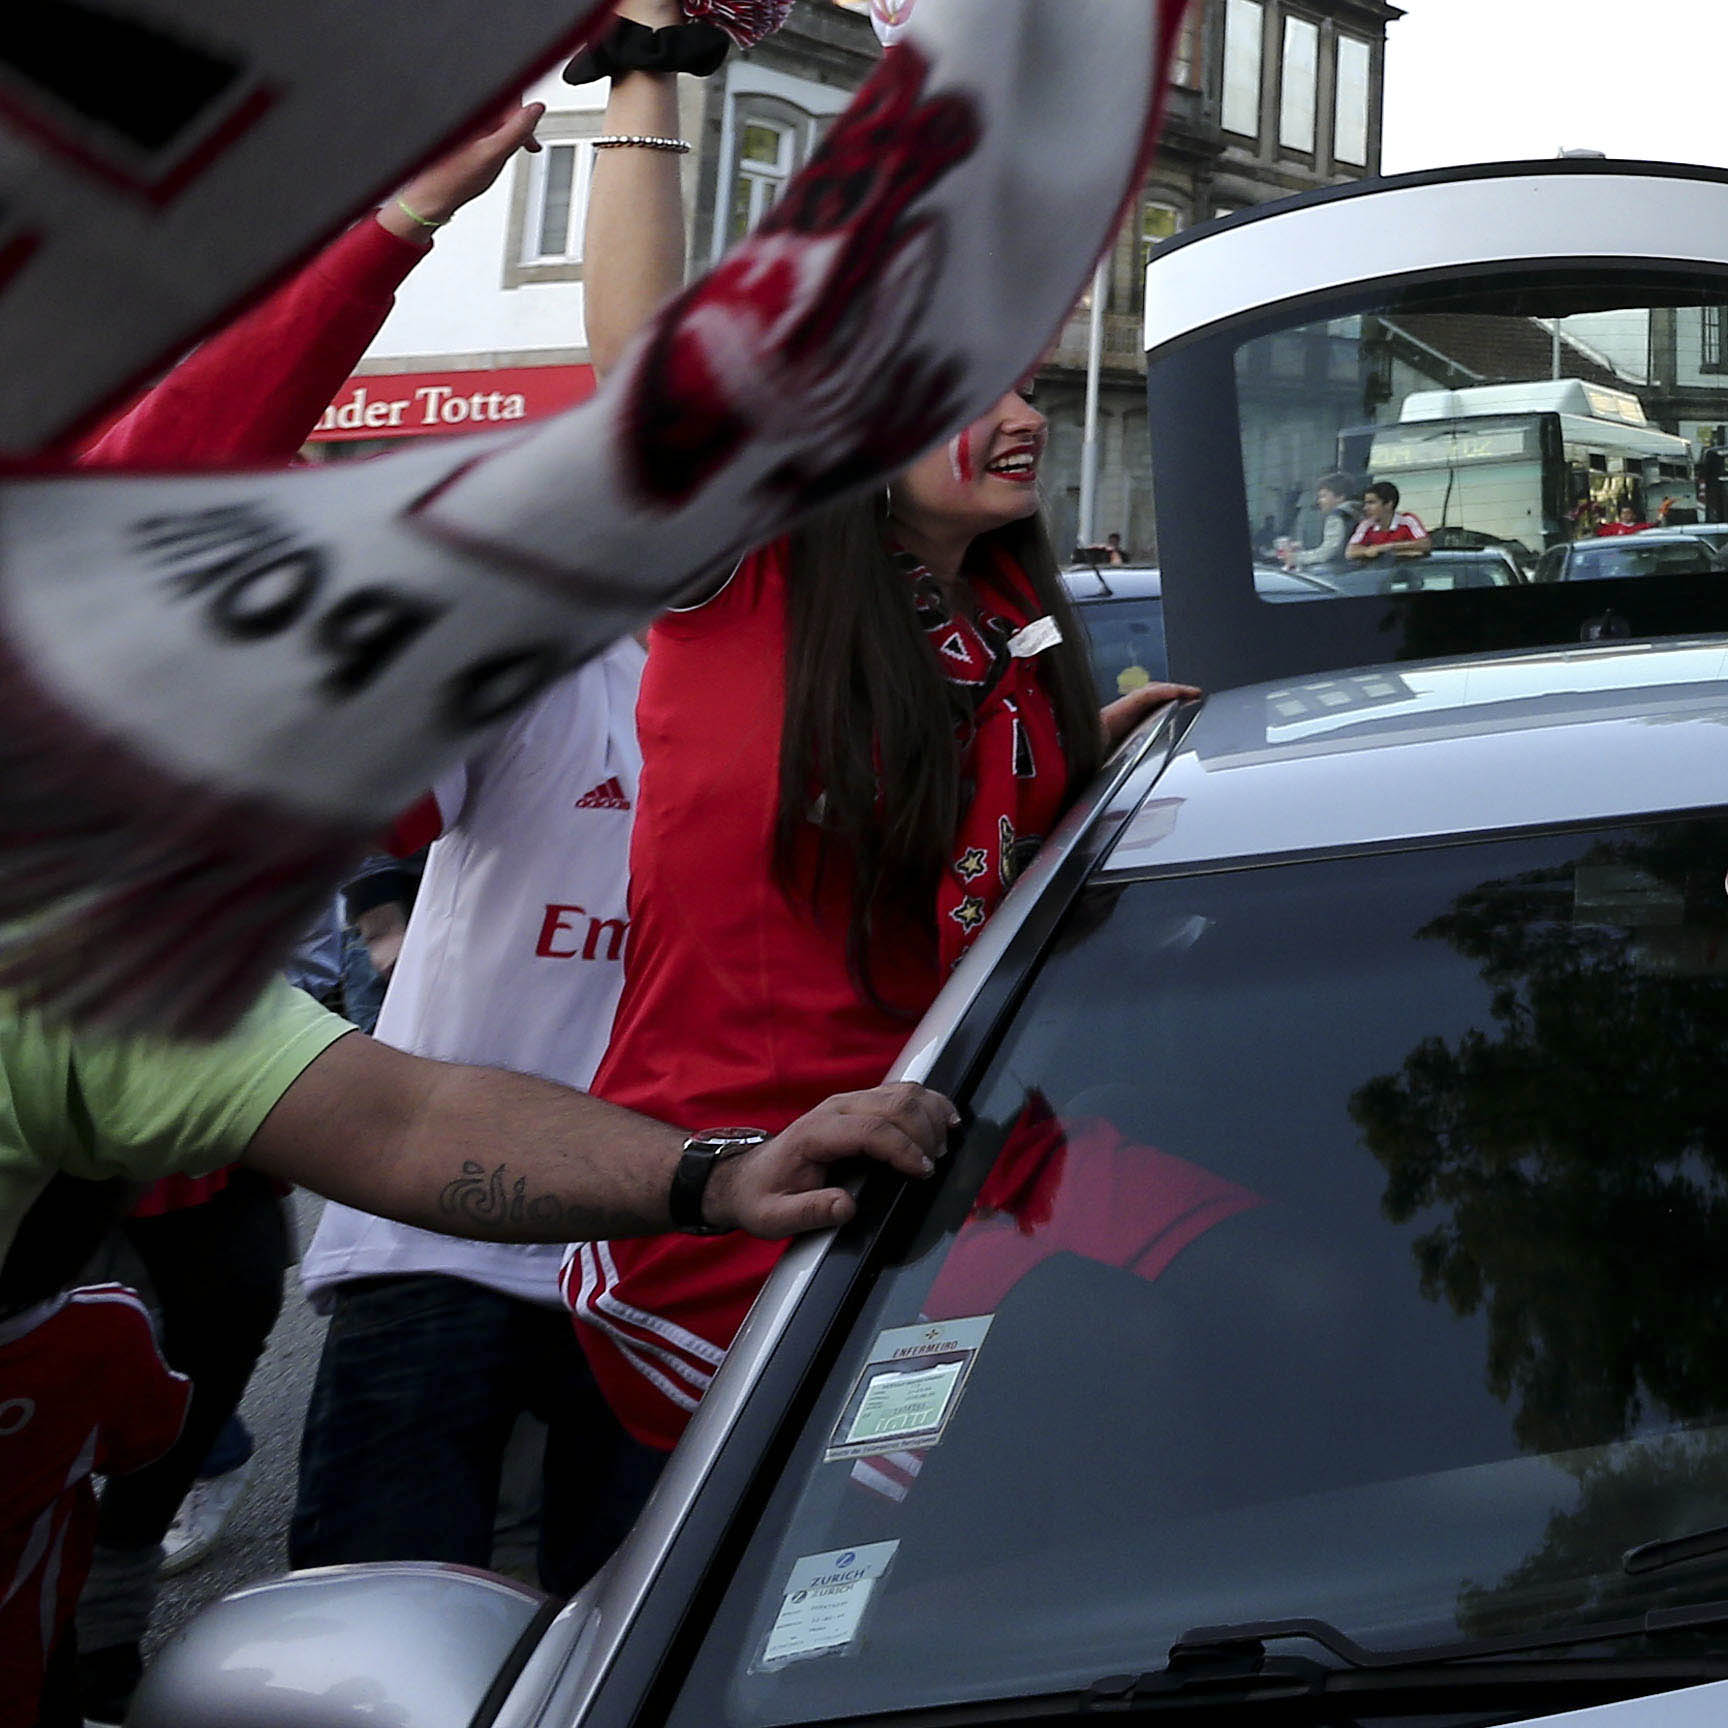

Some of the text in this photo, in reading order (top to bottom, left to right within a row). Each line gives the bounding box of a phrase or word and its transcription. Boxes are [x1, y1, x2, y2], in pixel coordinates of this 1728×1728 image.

[313, 385, 526, 432] nder Totta
[534, 903, 632, 962] Em
[810, 1569, 866, 1588] ZURICH
